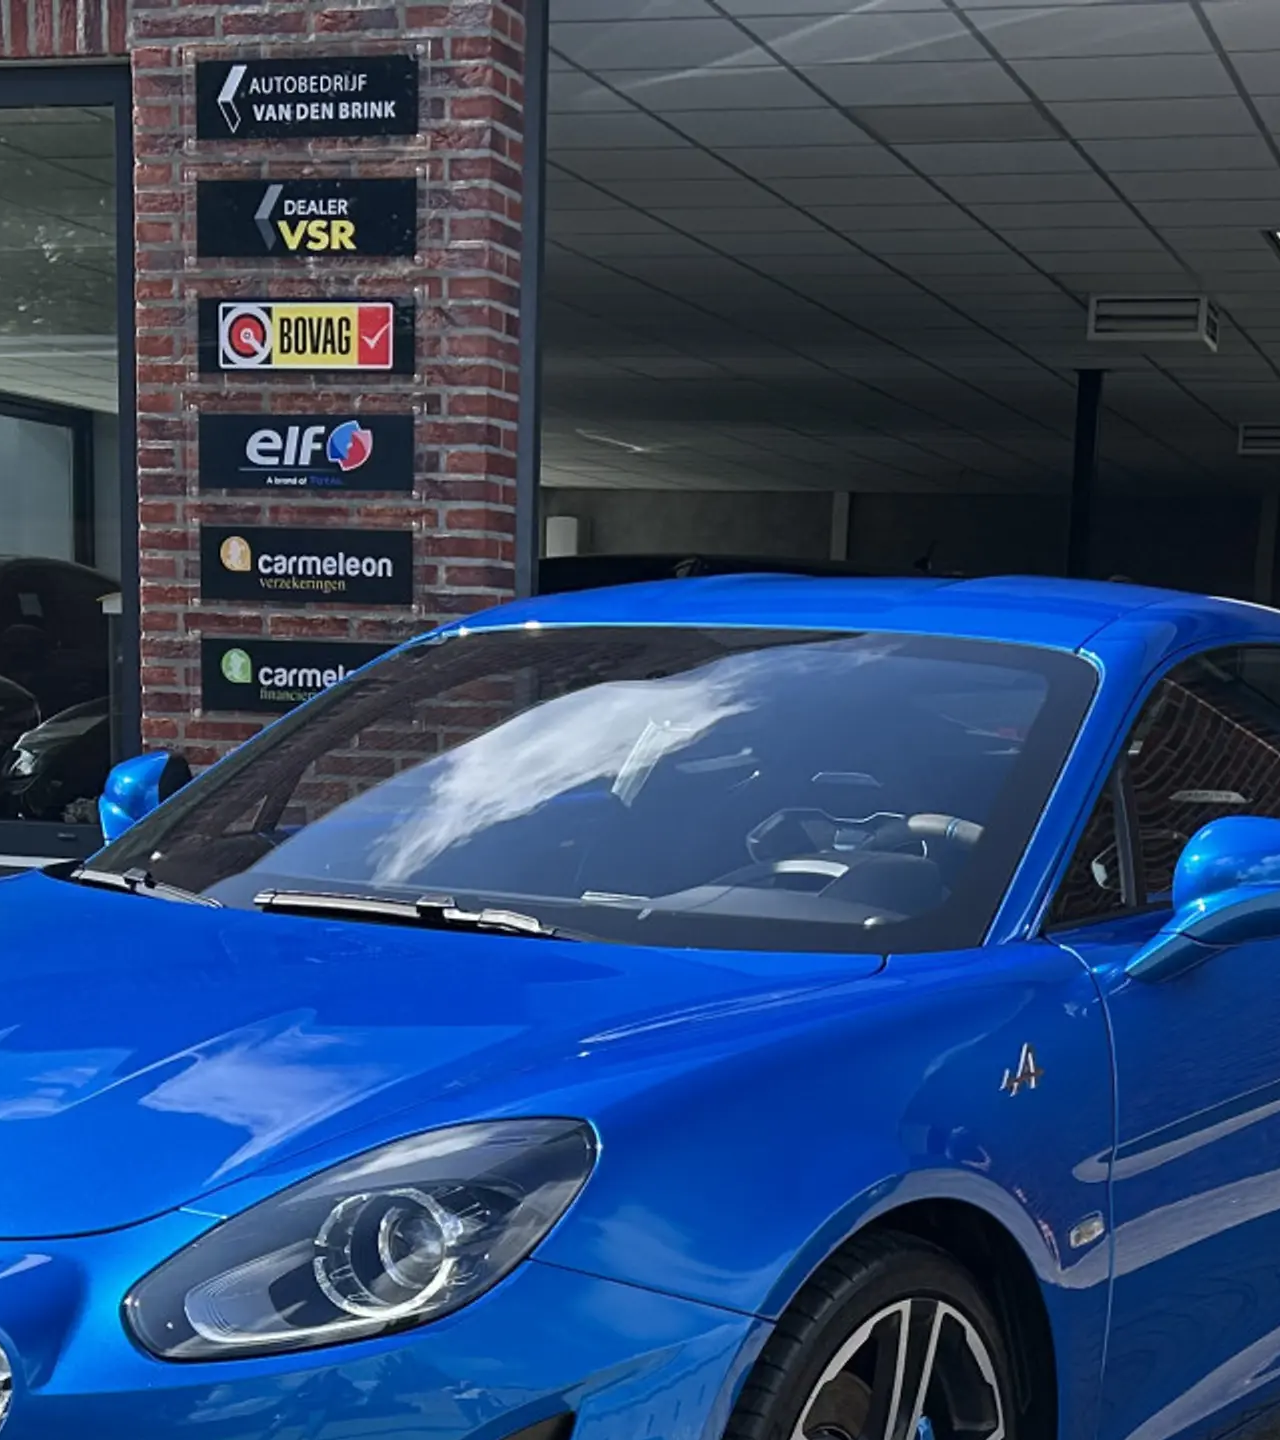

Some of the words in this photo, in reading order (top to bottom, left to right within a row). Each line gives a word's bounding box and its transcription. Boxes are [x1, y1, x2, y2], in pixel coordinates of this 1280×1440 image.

[249, 74, 368, 95] AUTOBEDRIJF
[253, 103, 291, 122] VAN
[296, 102, 333, 121] DEN
[338, 100, 397, 120] BRINK
[284, 199, 349, 216] DEALER
[277, 220, 357, 250] VSR
[279, 316, 352, 356] BOVAG
[246, 426, 325, 466] elf
[257, 552, 393, 578] carmeleon
[259, 576, 347, 594] verzekeringen
[258, 663, 356, 688] carmel
